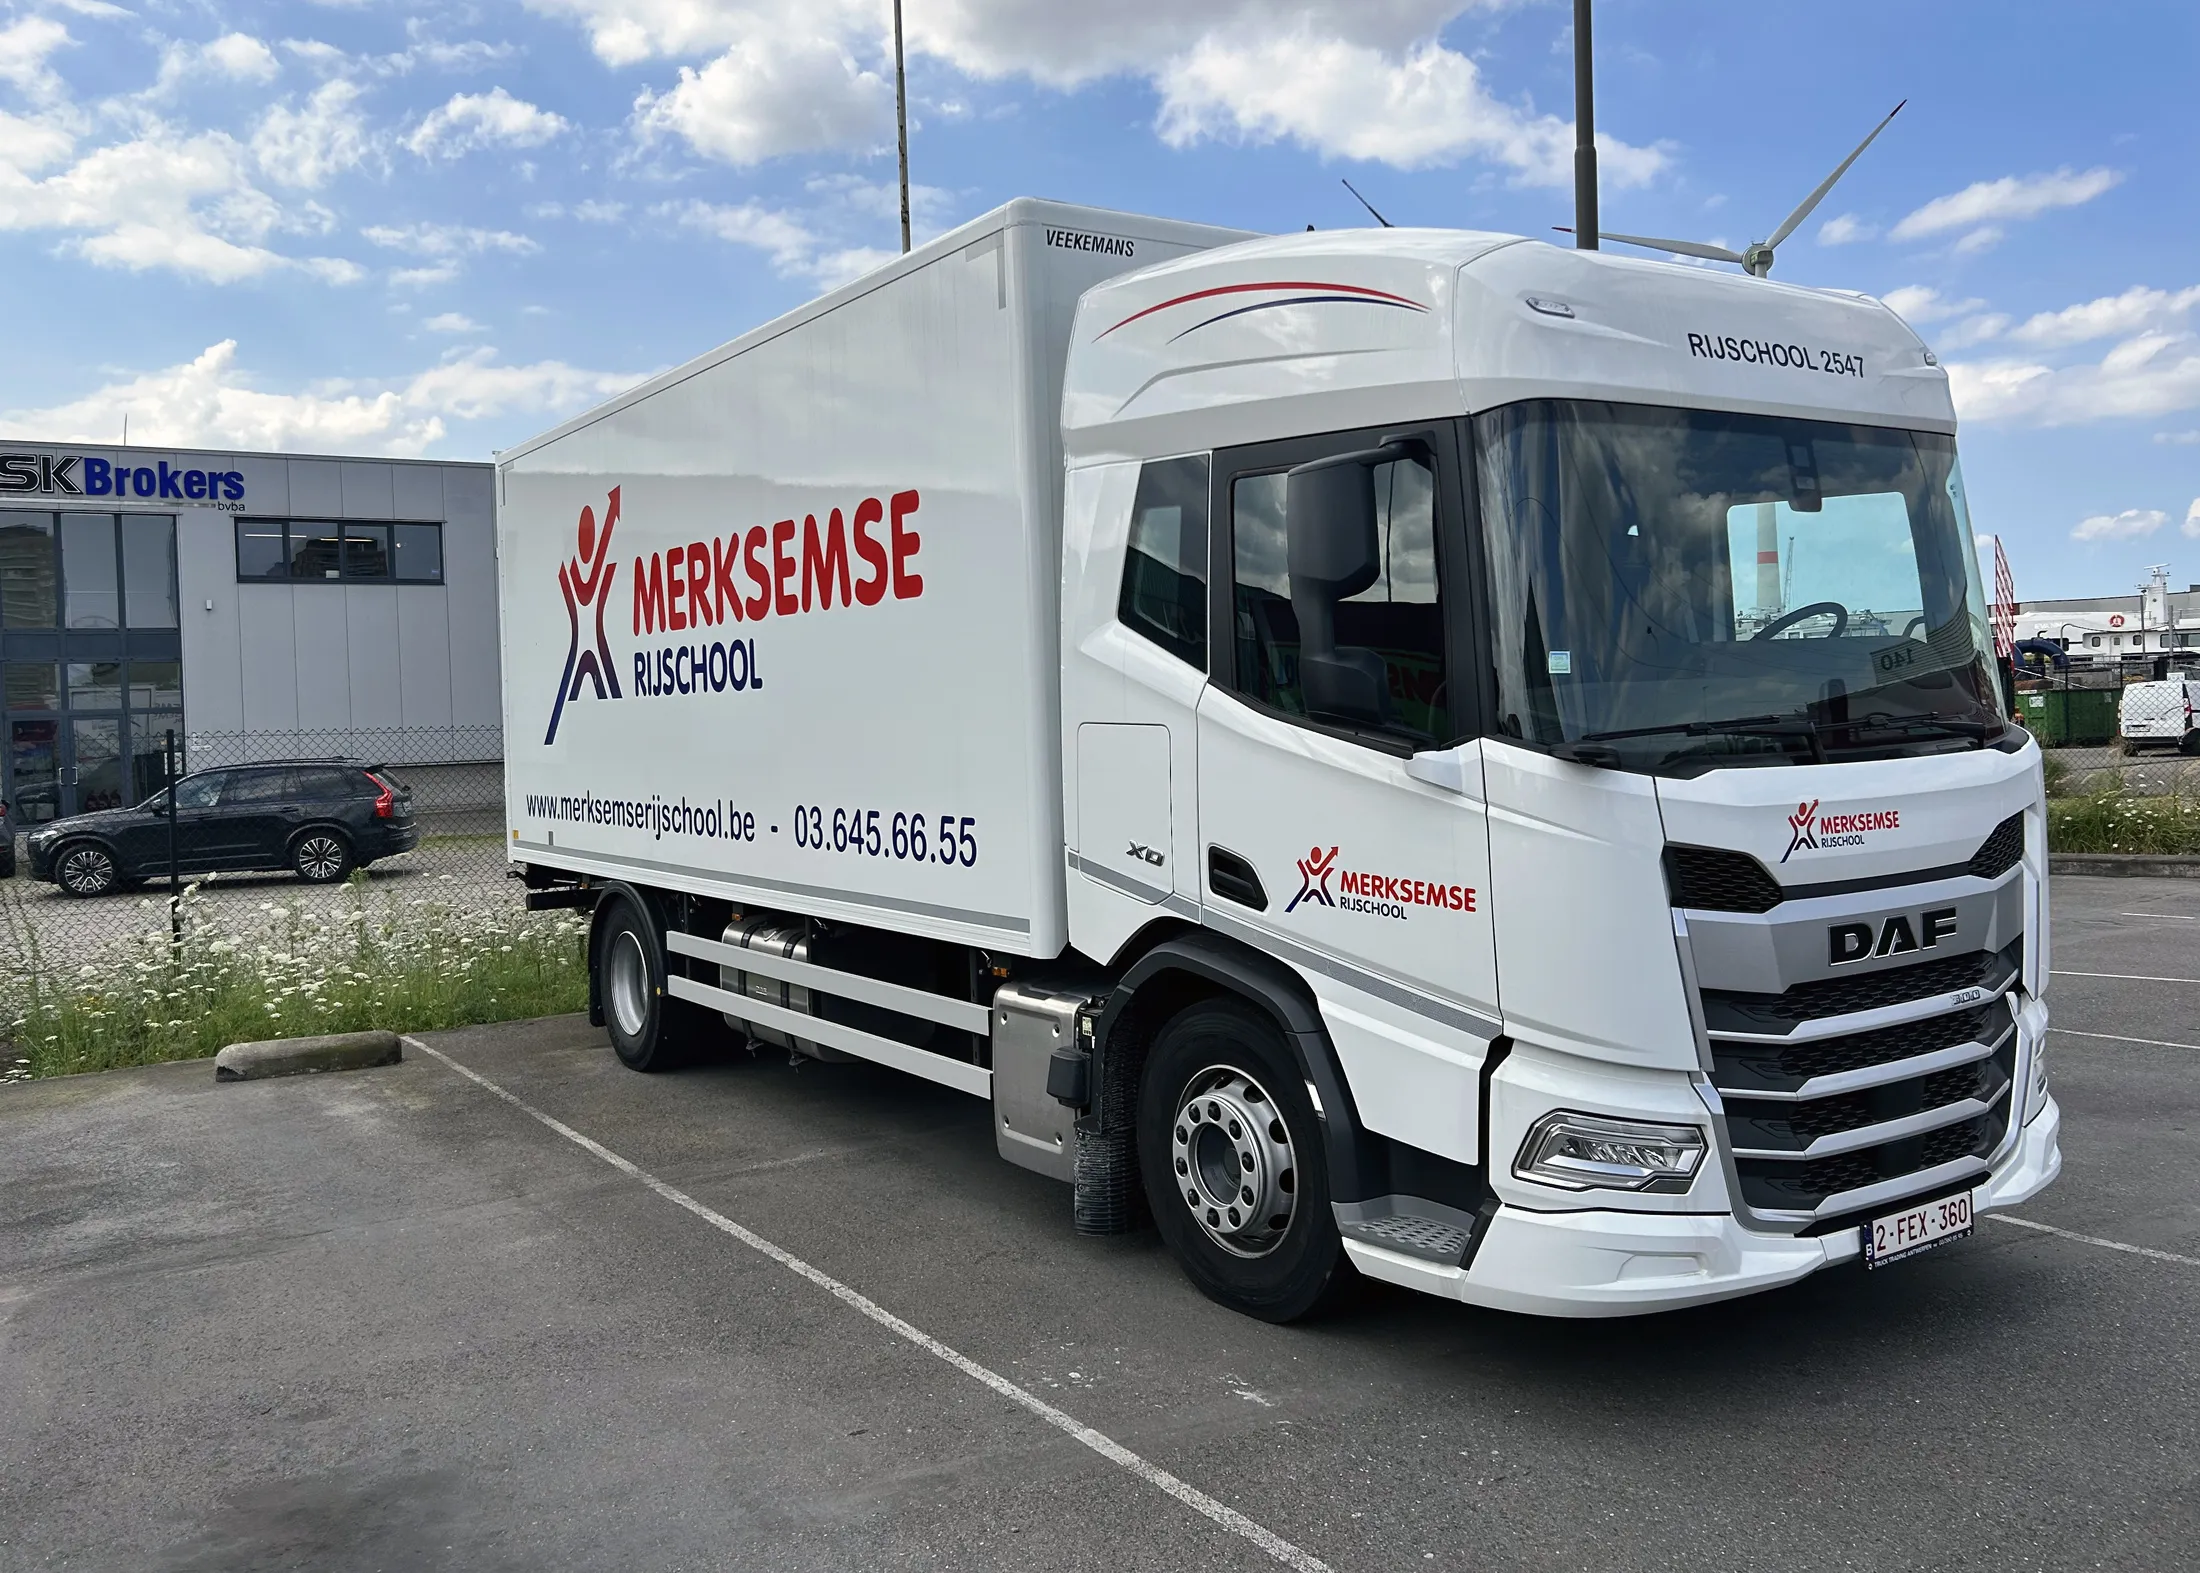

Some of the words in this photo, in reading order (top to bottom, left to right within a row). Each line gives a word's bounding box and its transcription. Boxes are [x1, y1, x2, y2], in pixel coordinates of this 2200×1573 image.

[1046, 229, 1134, 257] VEEKEMANS
[1687, 332, 1818, 371] RIJSCHOOL
[1820, 350, 1864, 379] 2547
[217, 501, 246, 512] bvba
[633, 489, 924, 637] MERKSEMSE
[634, 638, 763, 697] RIJSCHOOL
[526, 790, 755, 842] www.merksemserijschool.be
[794, 804, 978, 868] 03.645.66.55
[1821, 811, 1900, 834] MERKSEMSE
[1125, 839, 1166, 868] XD
[1821, 834, 1865, 848] RIJSCHOOL
[1340, 870, 1477, 913] MERKSEMSE
[1340, 896, 1408, 920] RIJSCHOOL
[1827, 906, 1958, 967] DAF
[1951, 989, 1981, 1006] 300
[1866, 1243, 1873, 1256] B
